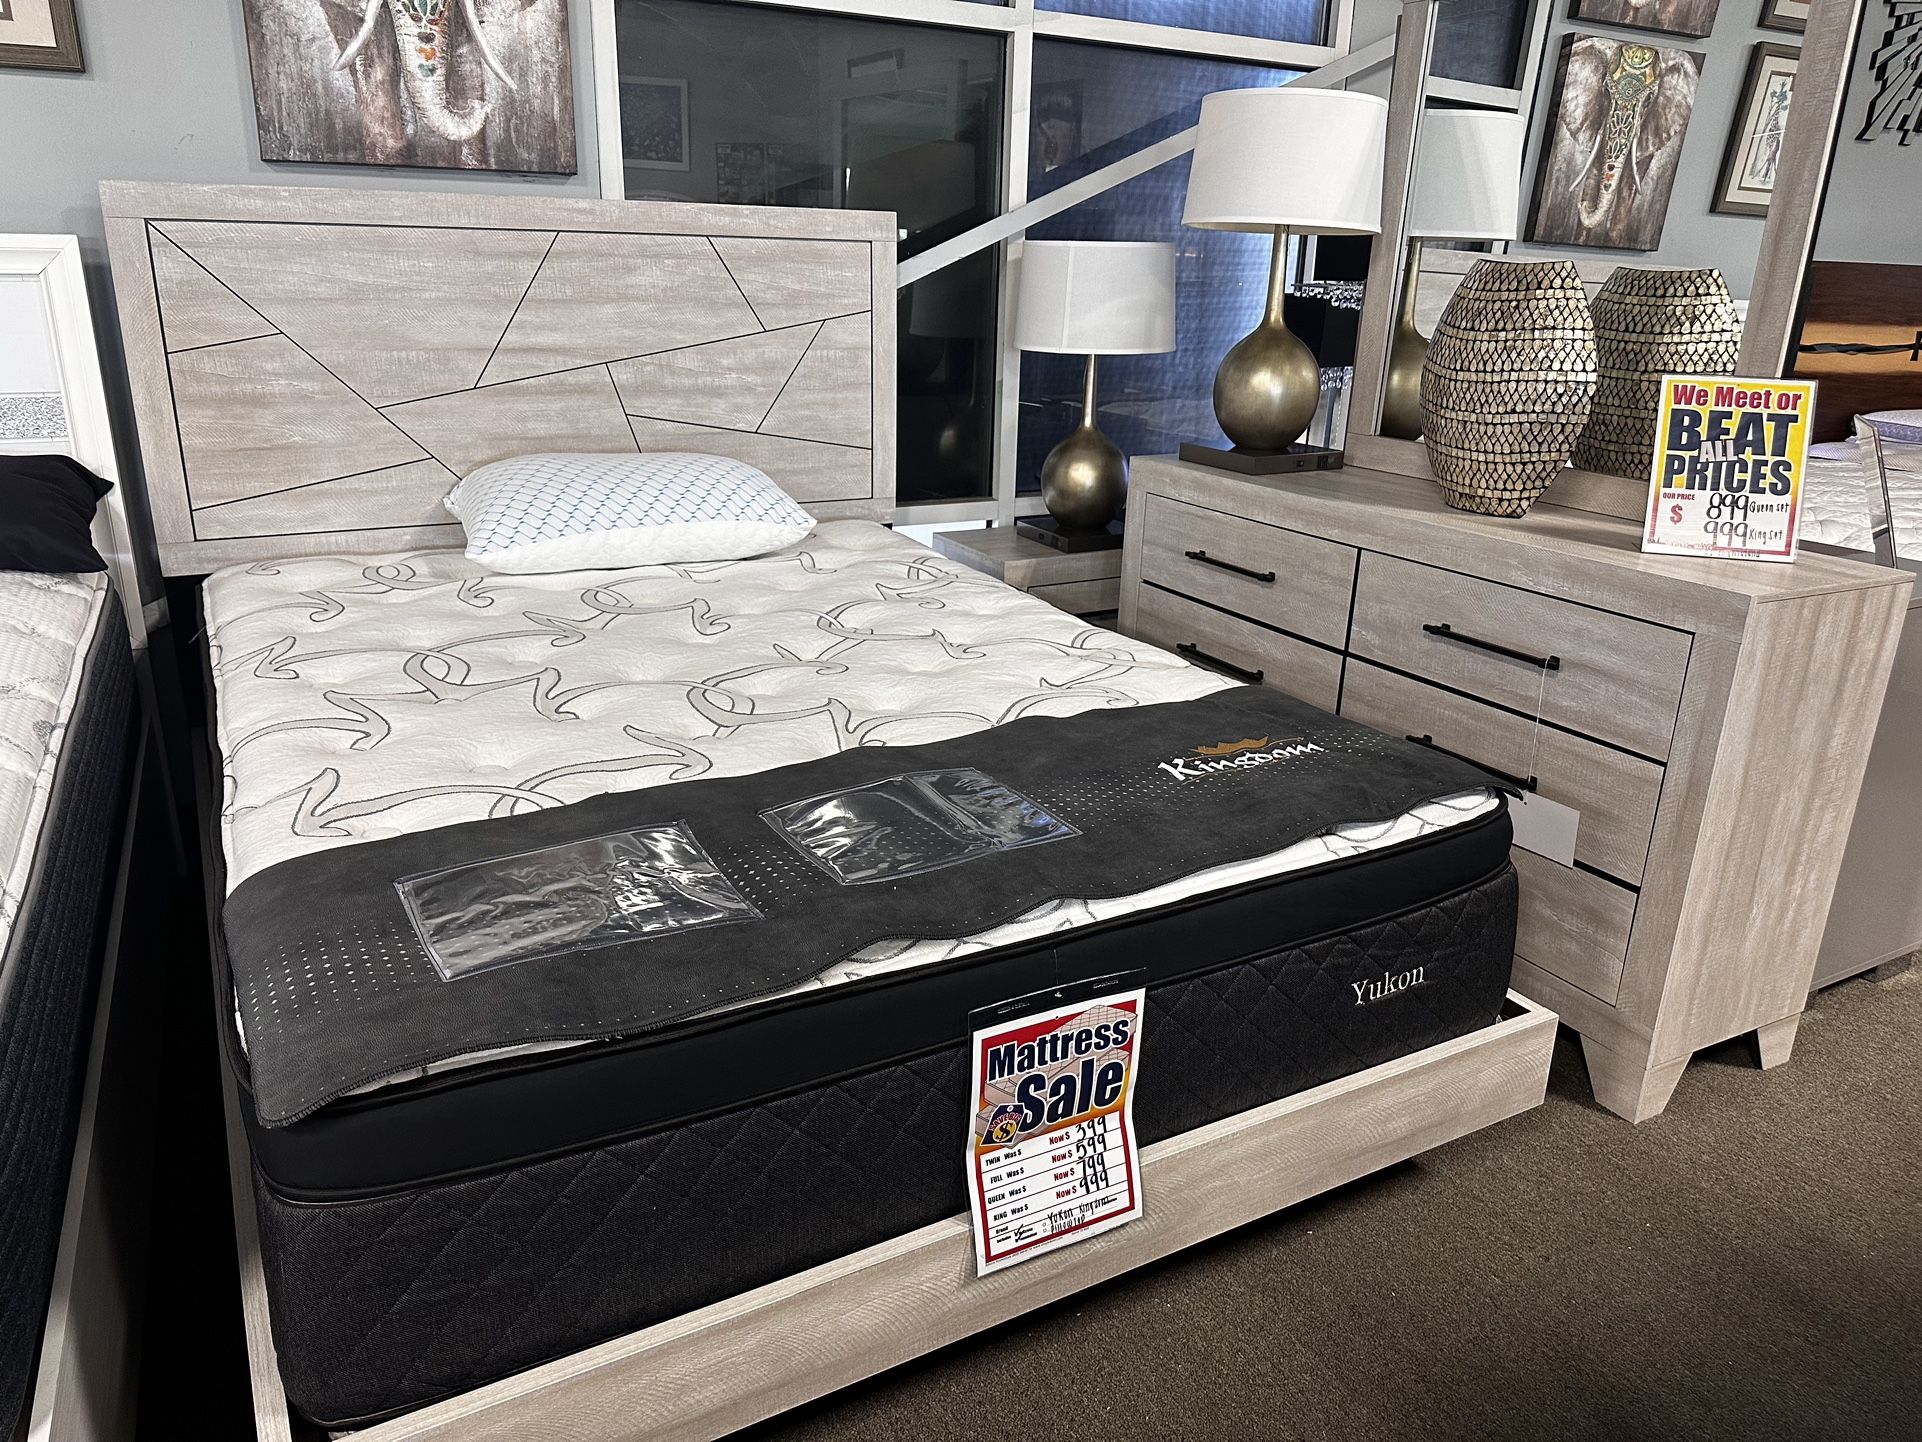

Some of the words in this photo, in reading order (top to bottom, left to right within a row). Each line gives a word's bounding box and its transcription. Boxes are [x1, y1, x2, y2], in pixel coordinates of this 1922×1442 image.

[1673, 384, 1709, 406] We
[1714, 386, 1772, 410] Meet
[1777, 392, 1802, 411] or
[1666, 408, 1799, 457] BEAT
[1700, 439, 1739, 462] ALL
[1662, 454, 1793, 496] PRICES
[1662, 492, 1676, 500] OUR
[1677, 492, 1696, 501] PRICE
[1669, 503, 1684, 525] $
[1706, 492, 1750, 521] 899
[1703, 521, 1749, 547] 999
[1157, 740, 1326, 781] Kingdom
[1351, 965, 1426, 1007] Yukon
[988, 1018, 1130, 1082] Mattress
[1016, 1058, 1125, 1132] Sale
[985, 1156, 1001, 1166] TWIN
[1075, 1116, 1107, 1141] 399
[990, 1174, 1003, 1184] FULL
[1076, 1133, 1107, 1160] 599
[987, 1193, 1005, 1204] QUEEN
[1076, 1152, 1106, 1177] 799
[993, 1211, 1007, 1221] KING
[1079, 1170, 1110, 1194] 999
